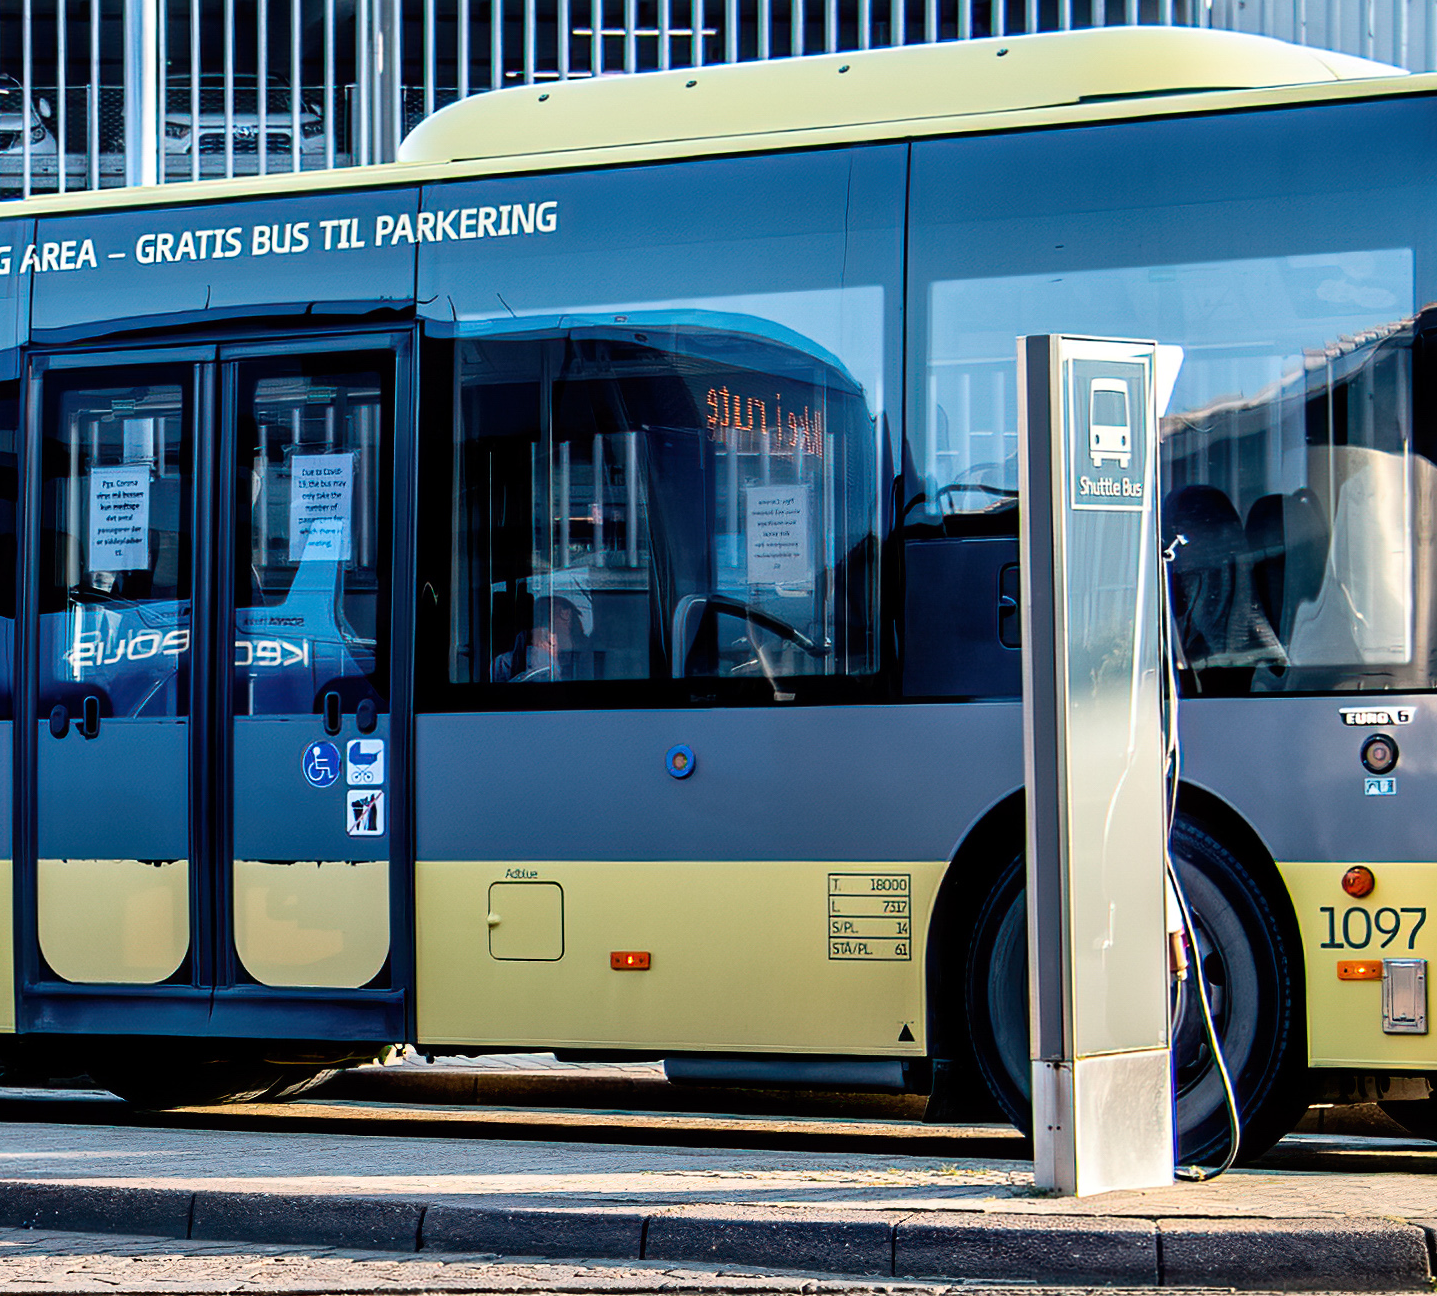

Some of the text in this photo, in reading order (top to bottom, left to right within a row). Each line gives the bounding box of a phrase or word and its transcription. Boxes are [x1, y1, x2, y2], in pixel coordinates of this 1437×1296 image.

[19, 238, 98, 274] AREA
[135, 227, 242, 264] GRATIS
[251, 222, 310, 256] BUS
[319, 218, 365, 250] TIL
[374, 201, 558, 247] PARKERING
[1080, 476, 1143, 497] Shuttle Bus
[1398, 710, 1409, 723] 6
[871, 878, 907, 891] 18000
[1320, 907, 1426, 949] 1097
